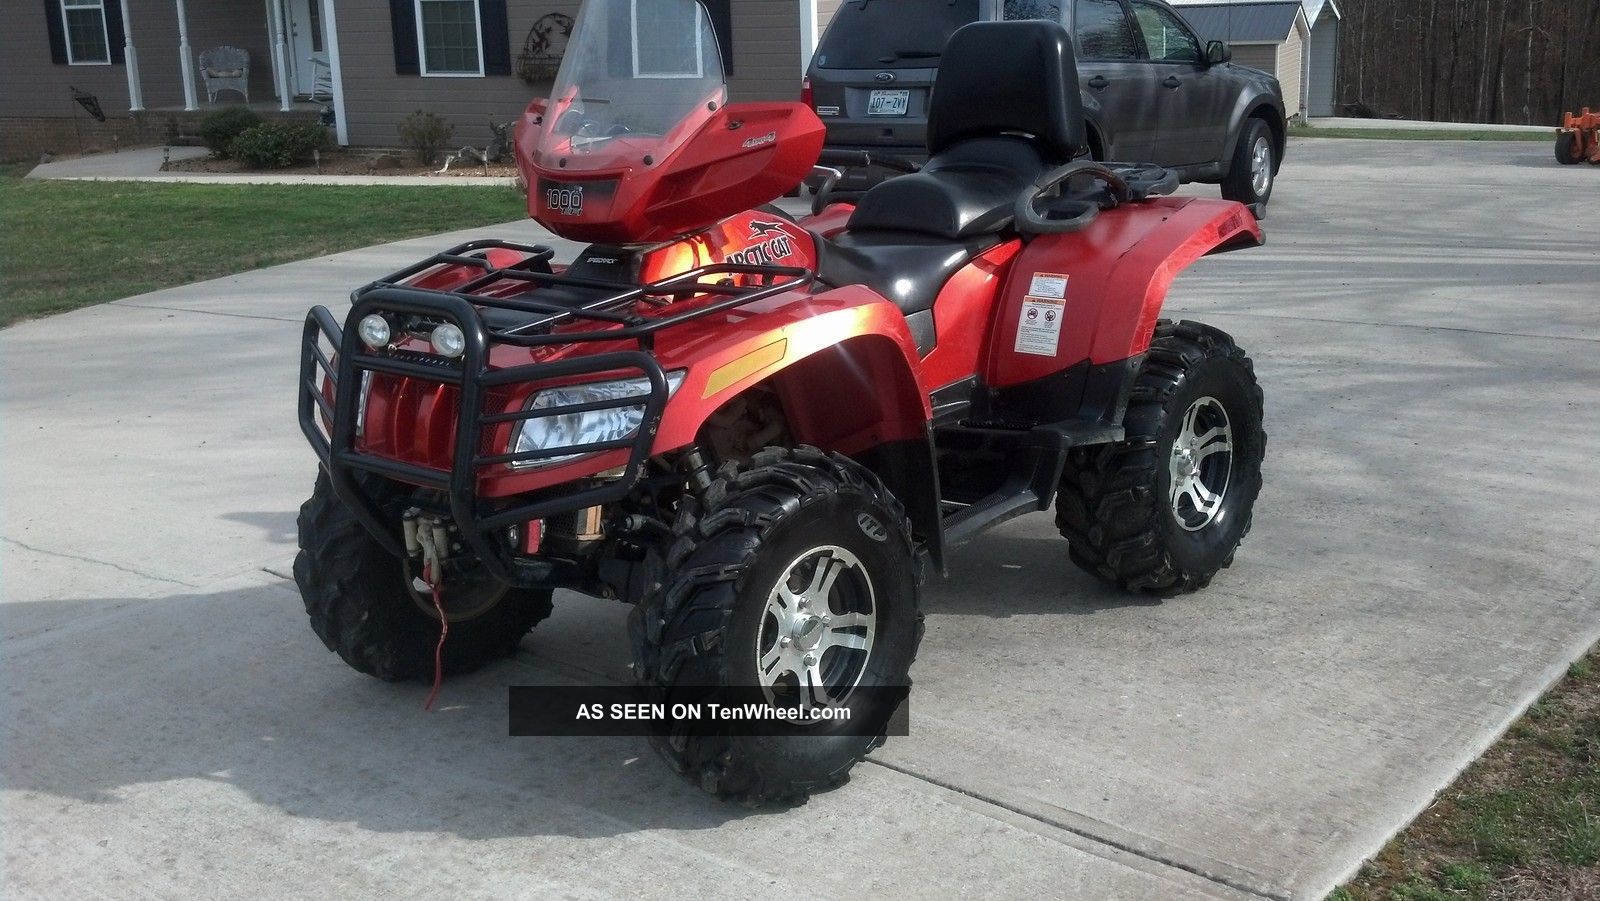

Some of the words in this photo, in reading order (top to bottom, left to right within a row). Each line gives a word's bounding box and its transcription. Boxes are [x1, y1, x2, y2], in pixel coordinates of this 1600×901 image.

[547, 188, 583, 209] 1000
[725, 241, 773, 266] ARCTIC
[769, 235, 792, 260] CAT
